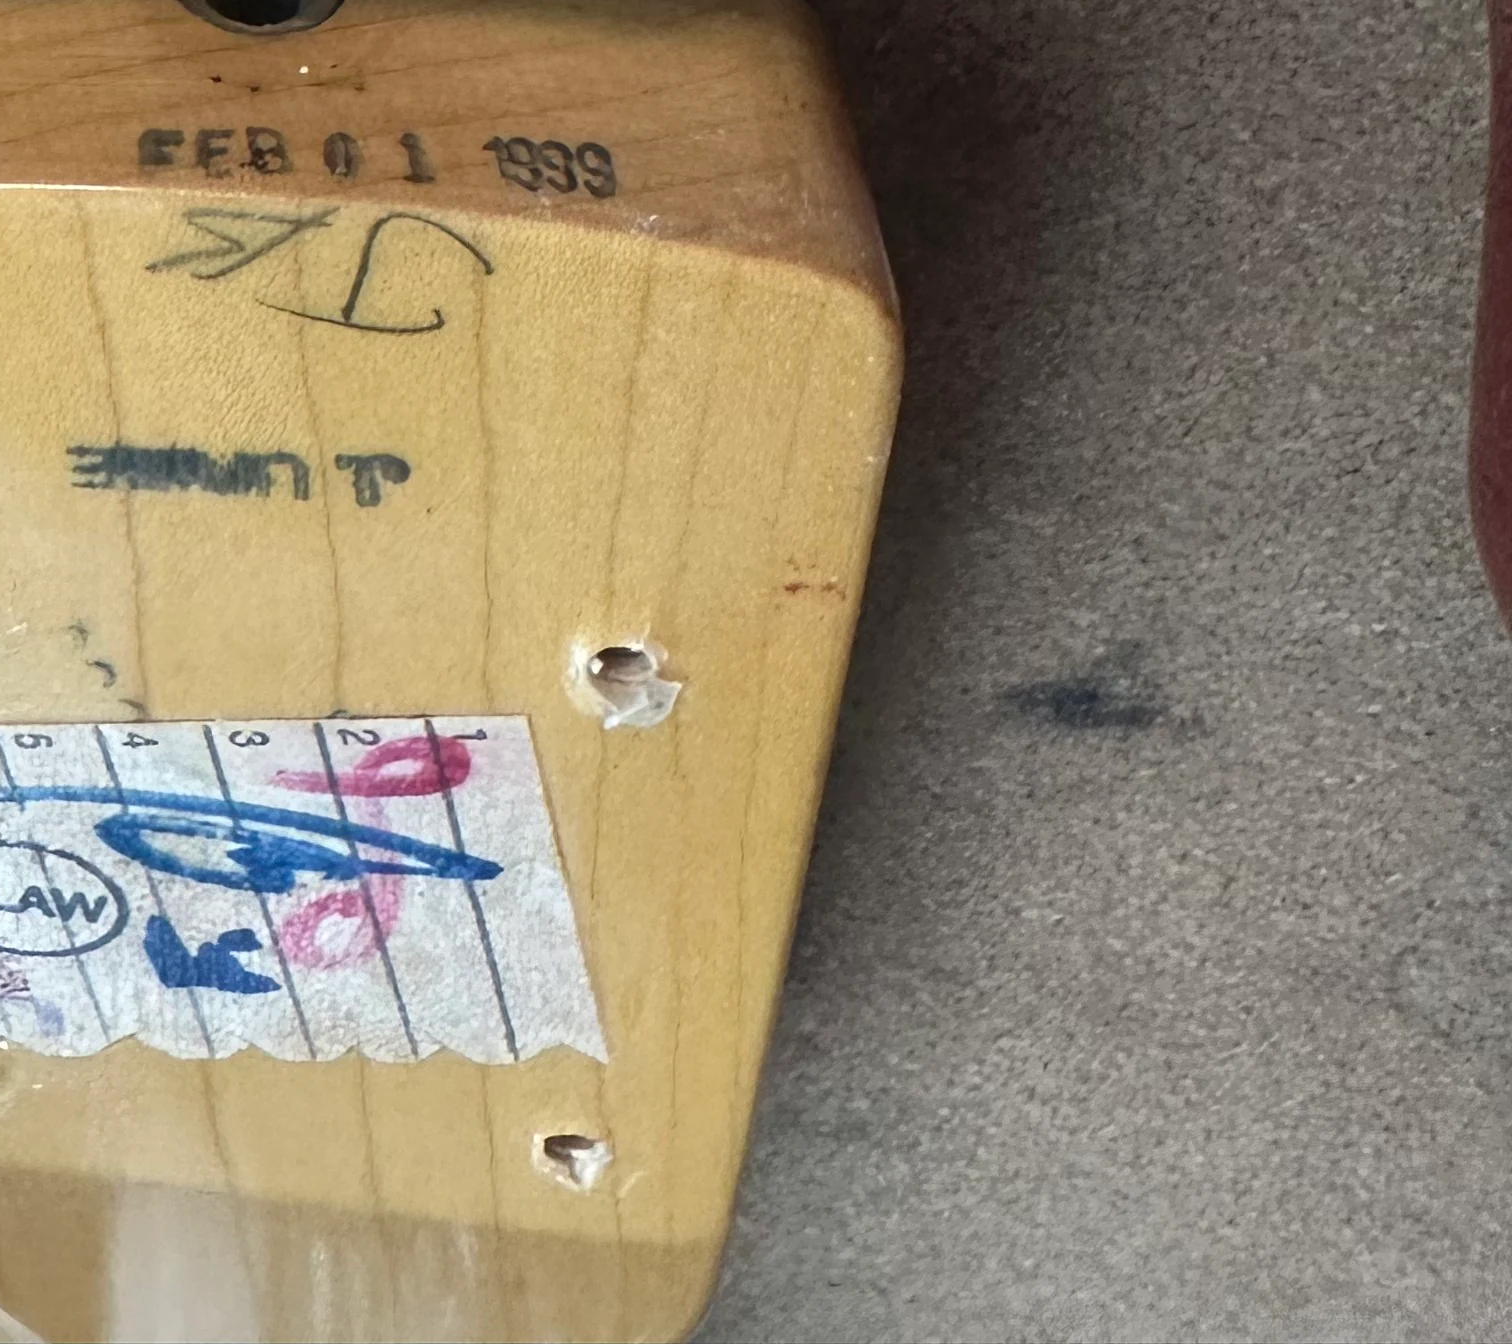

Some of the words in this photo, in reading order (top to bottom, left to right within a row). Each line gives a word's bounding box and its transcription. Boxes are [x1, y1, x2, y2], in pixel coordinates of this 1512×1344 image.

[135, 124, 294, 177] FEB
[13, 731, 55, 750] 5
[120, 731, 160, 749] 4
[227, 727, 271, 748] 3
[335, 726, 382, 746] 2
[451, 726, 489, 741] 1
